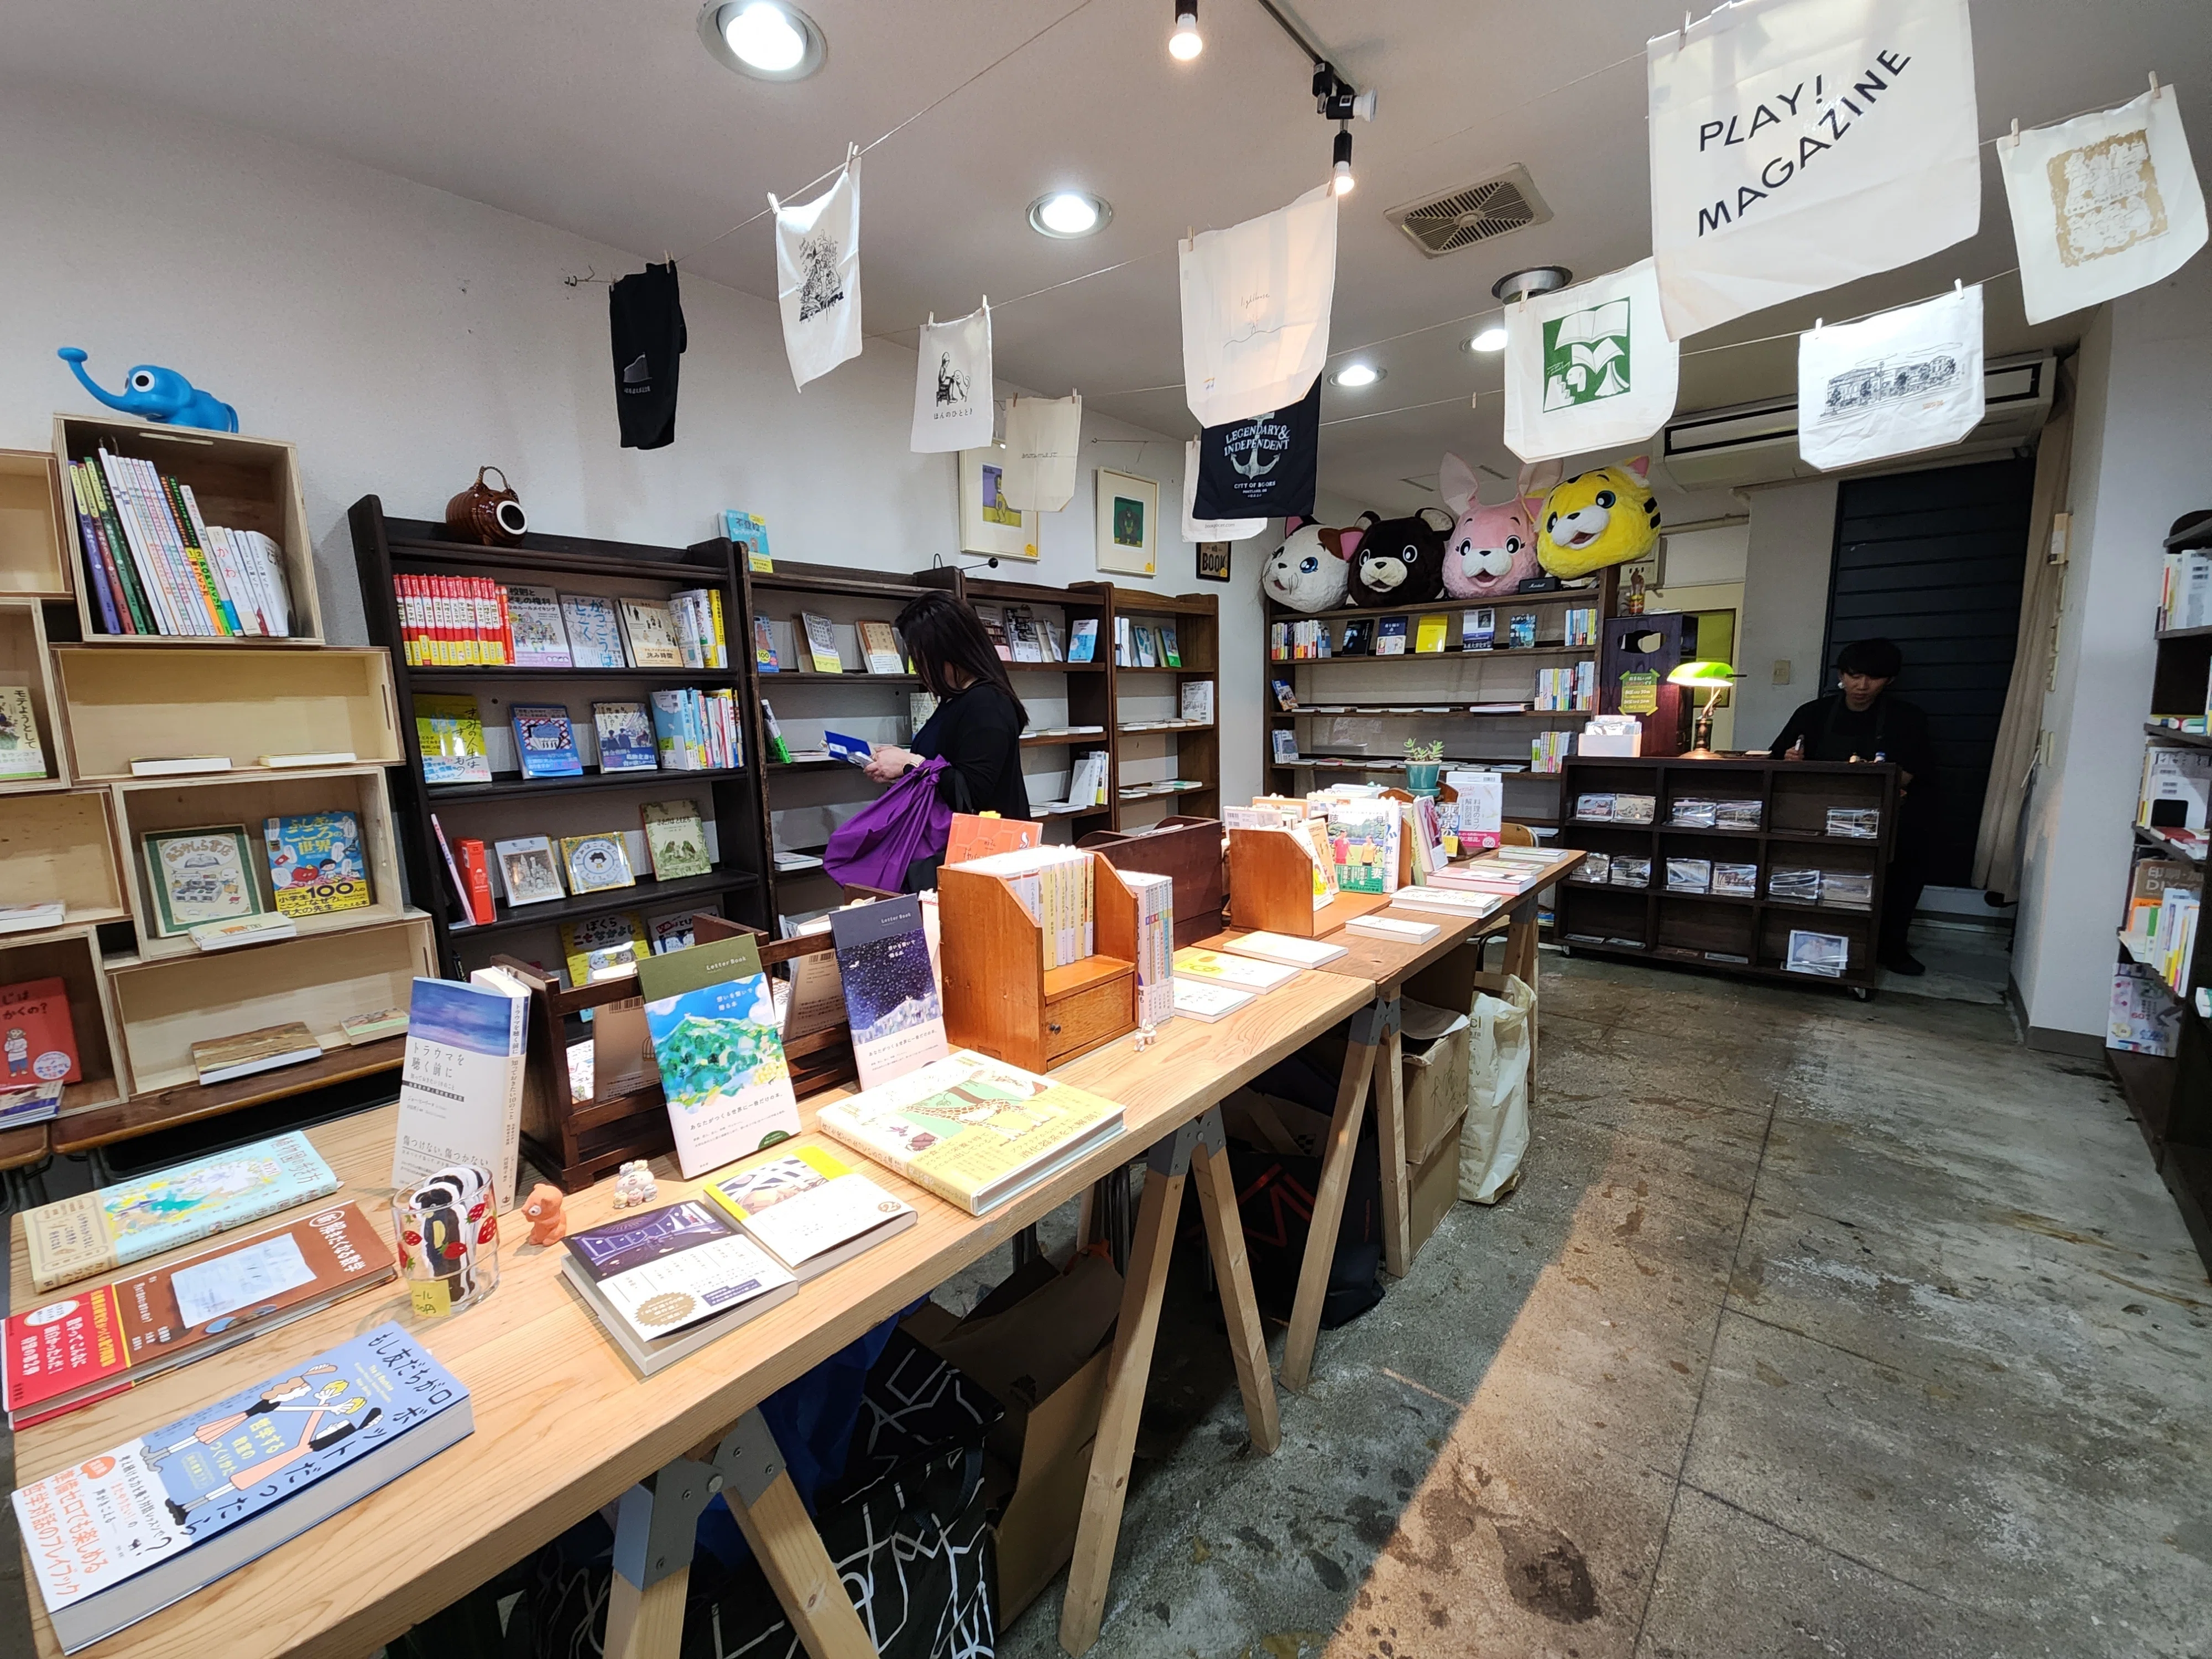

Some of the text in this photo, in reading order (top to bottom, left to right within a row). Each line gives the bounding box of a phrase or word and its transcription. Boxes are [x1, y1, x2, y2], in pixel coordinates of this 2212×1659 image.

[1699, 74, 1823, 153] PLAY!
[1698, 49, 1912, 237] MAGAZINE
[1240, 291, 1271, 309] lighthouse
[1224, 439, 1290, 457] INDEPENDENT
[1202, 552, 1227, 573] BOOK
[1441, 804, 1458, 837] 東京の
[1464, 798, 1472, 826] 解剖図鑑
[1473, 798, 1481, 830] 料理のコツ
[298, 839, 332, 855] 世界
[586, 917, 617, 931] ぼくら
[880, 915, 898, 924] Letter
[706, 956, 747, 971] Letter Book
[512, 1003, 521, 1055] トラウマを聴く前に
[411, 1056, 453, 1078] 聴く前に
[414, 1042, 465, 1066] トラウマを
[508, 1060, 519, 1120] 知っておきたい10のこと
[403, 1134, 489, 1166] 傷つけない、傷つかない
[1020, 1111, 1102, 1159] 消化器系を大解剖!
[269, 1135, 324, 1185] 植物園の歩き方
[318, 1221, 367, 1273] 解きたくなる数学
[249, 1416, 286, 1455] 哲学する
[209, 1441, 238, 1477] つくりかた
[51, 1470, 109, 1574] 準備ゼロでも楽しめる
[21, 1481, 81, 1596] 哲学対話のプレイブック
